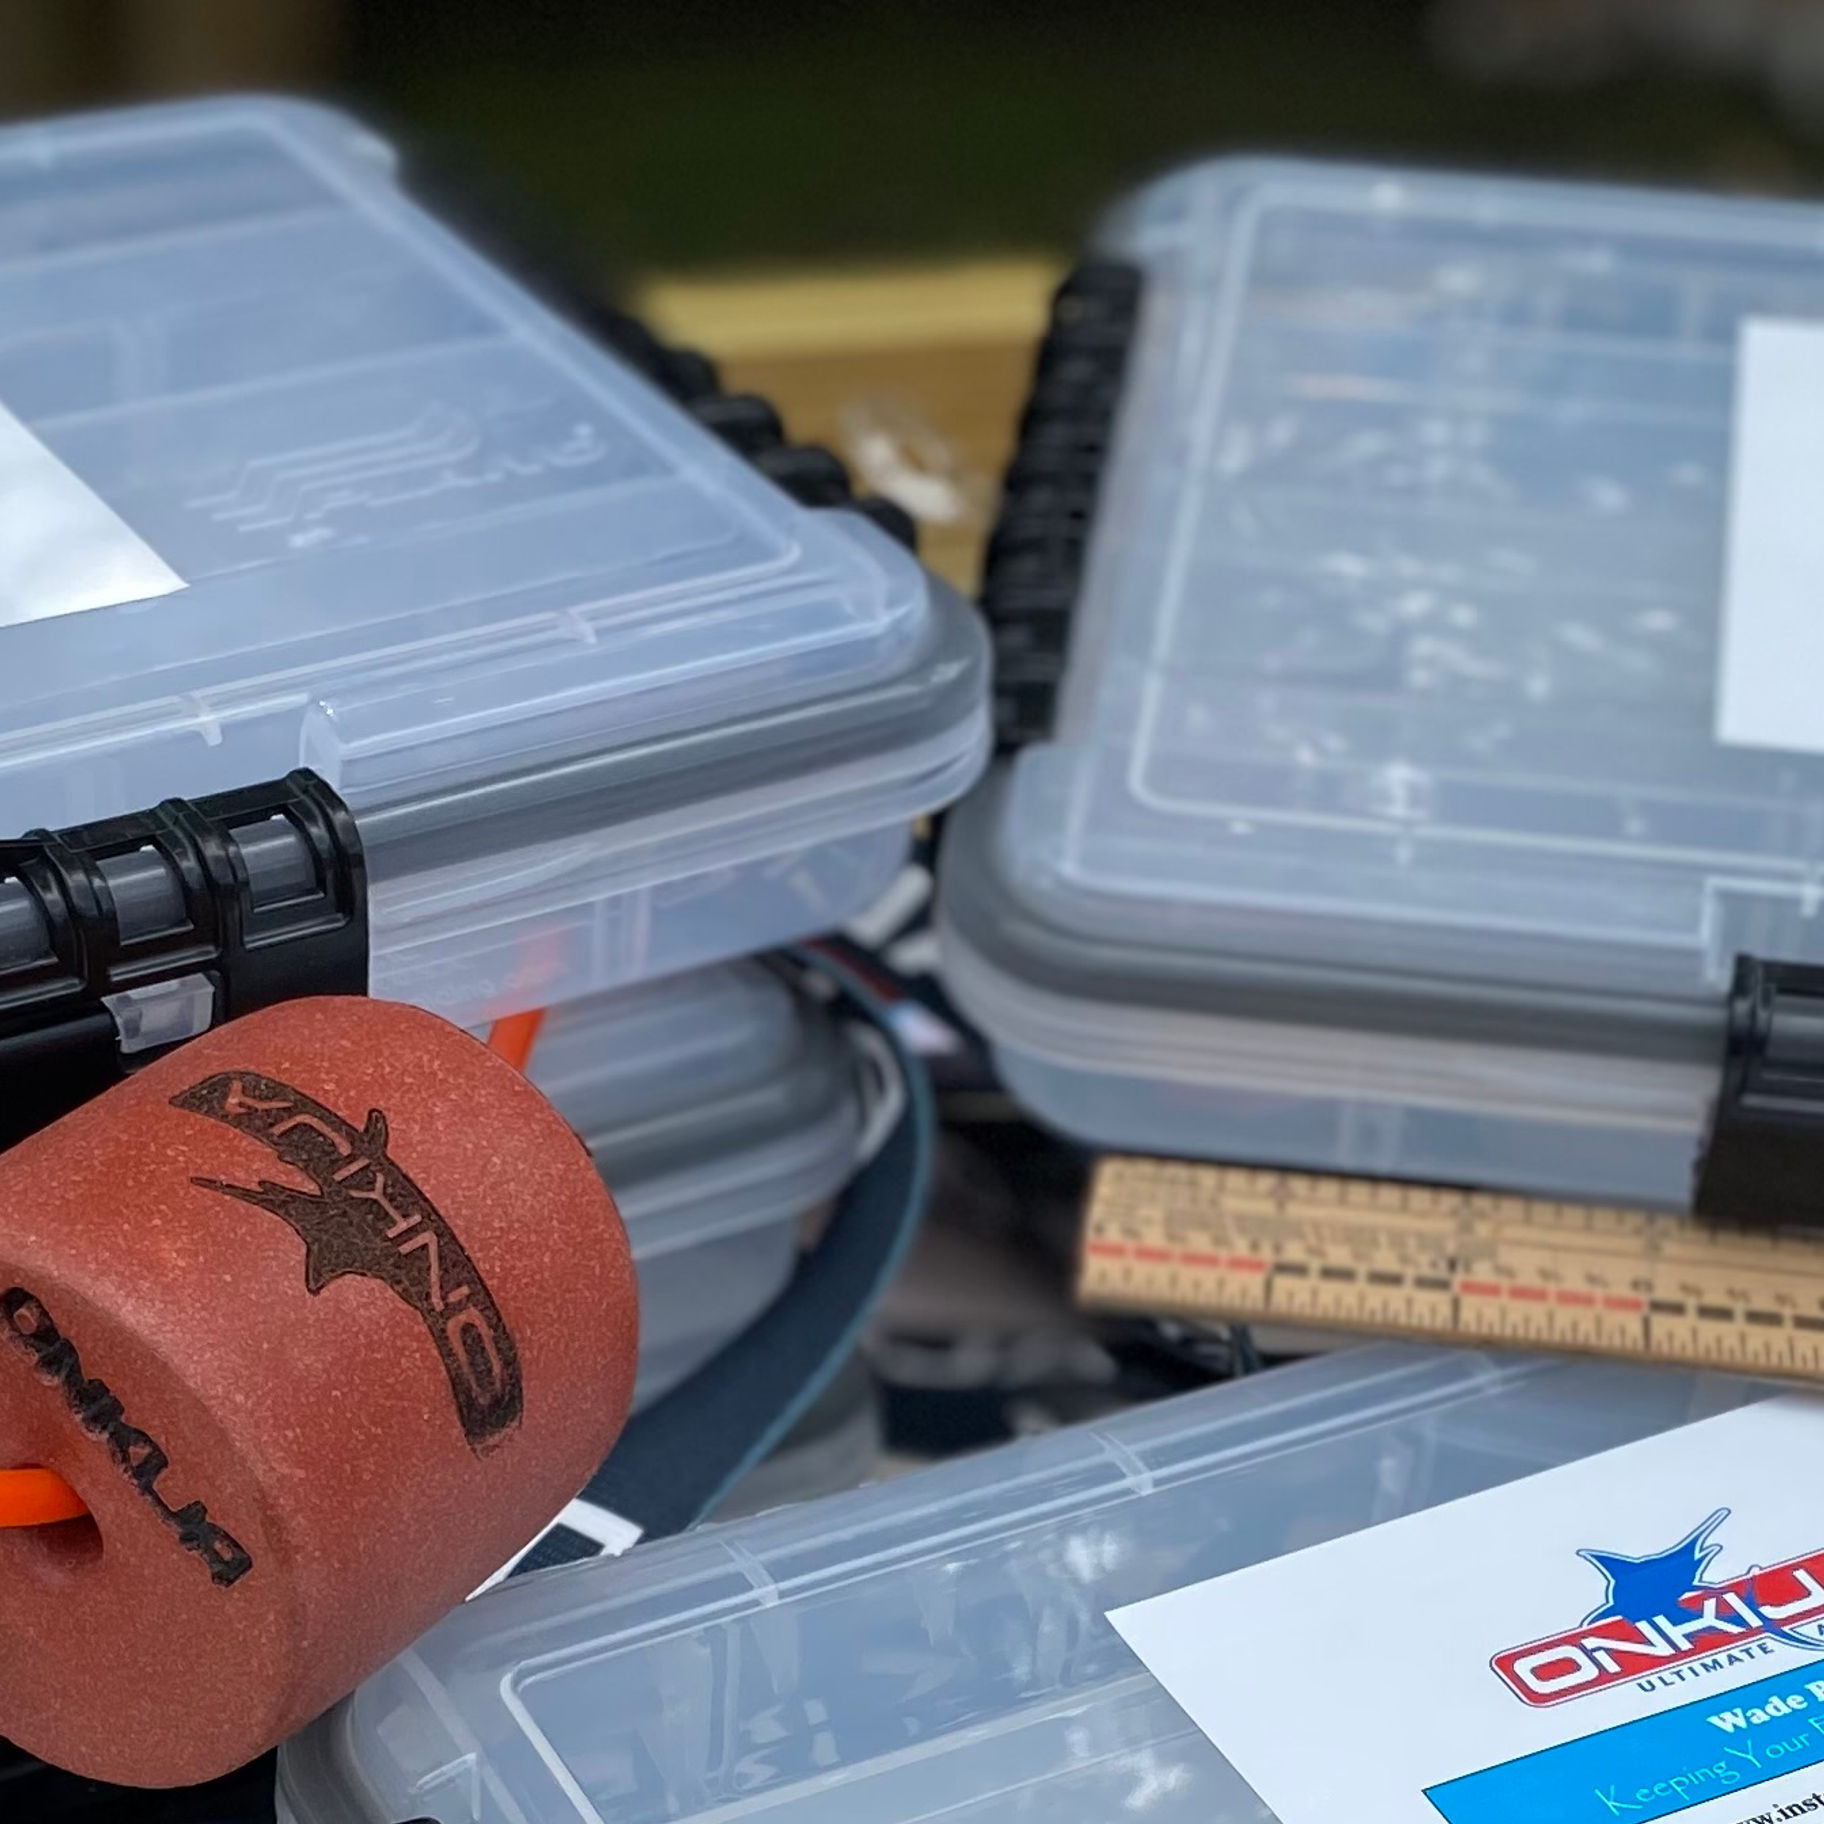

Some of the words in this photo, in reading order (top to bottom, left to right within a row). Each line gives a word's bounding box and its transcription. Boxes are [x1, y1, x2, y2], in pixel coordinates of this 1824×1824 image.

[1636, 1641, 1776, 1694] ULTIMATE
[1706, 1692, 1809, 1735] Wade
[1594, 1759, 1742, 1817] Keeping
[1724, 1733, 1811, 1771] Your
